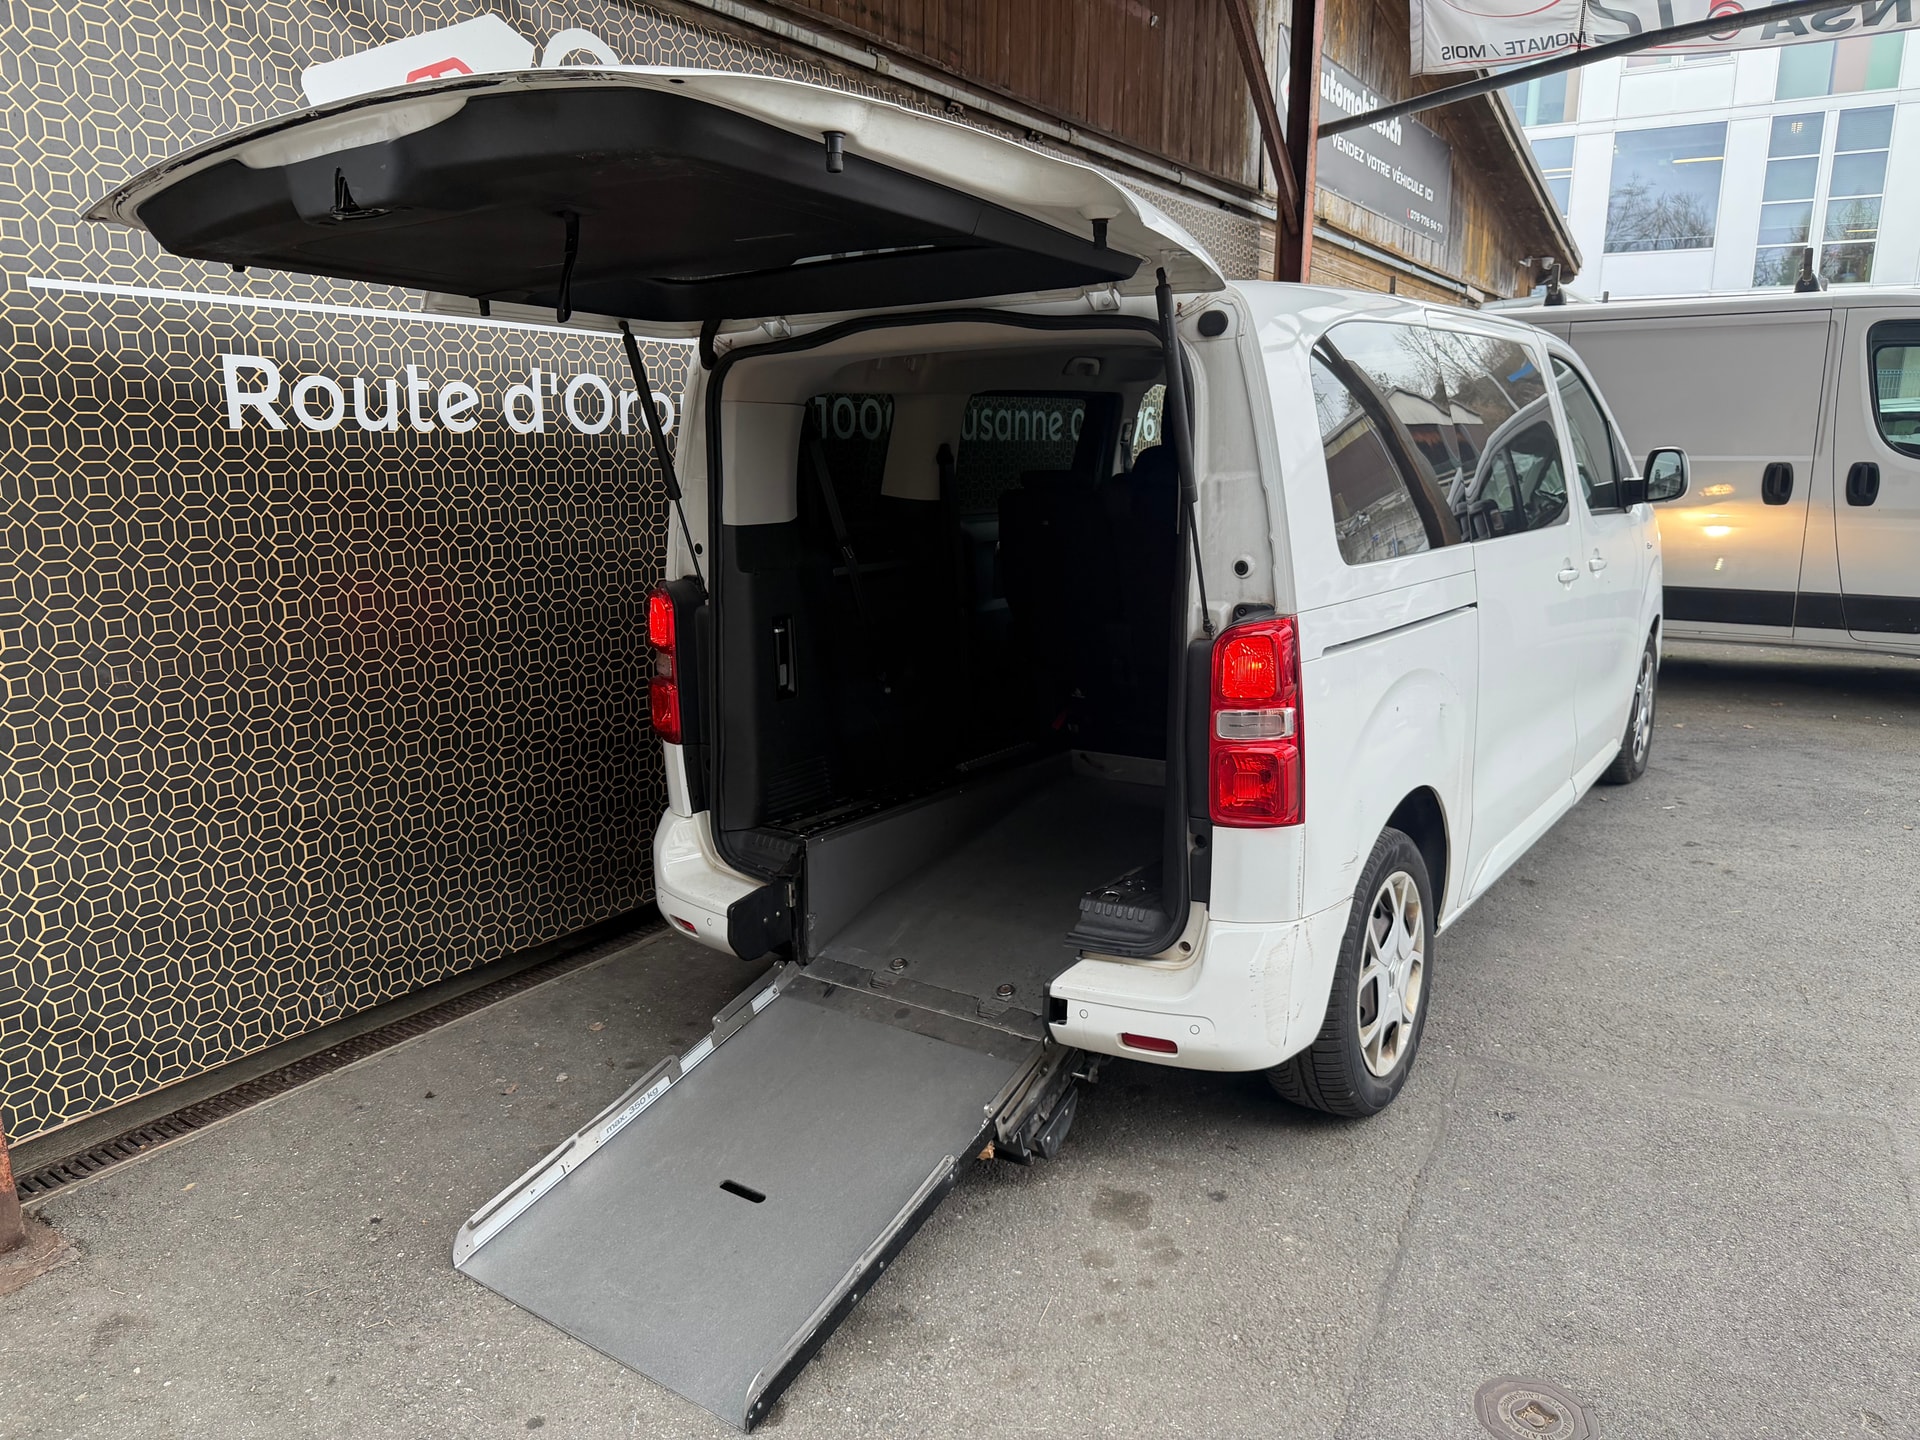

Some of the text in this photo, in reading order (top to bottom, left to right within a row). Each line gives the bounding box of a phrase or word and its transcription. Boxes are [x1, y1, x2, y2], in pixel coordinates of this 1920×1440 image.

[1320, 68, 1402, 146] utomobiles.ch
[1331, 132, 1365, 164] VENDEZ
[1366, 152, 1391, 178] VOTRE
[1392, 165, 1425, 197] VÉHICULE
[222, 353, 480, 432] Route
[504, 368, 685, 435] d'Oro
[961, 408, 1063, 441] usanne
[605, 1087, 659, 1135] max. 350 kg
